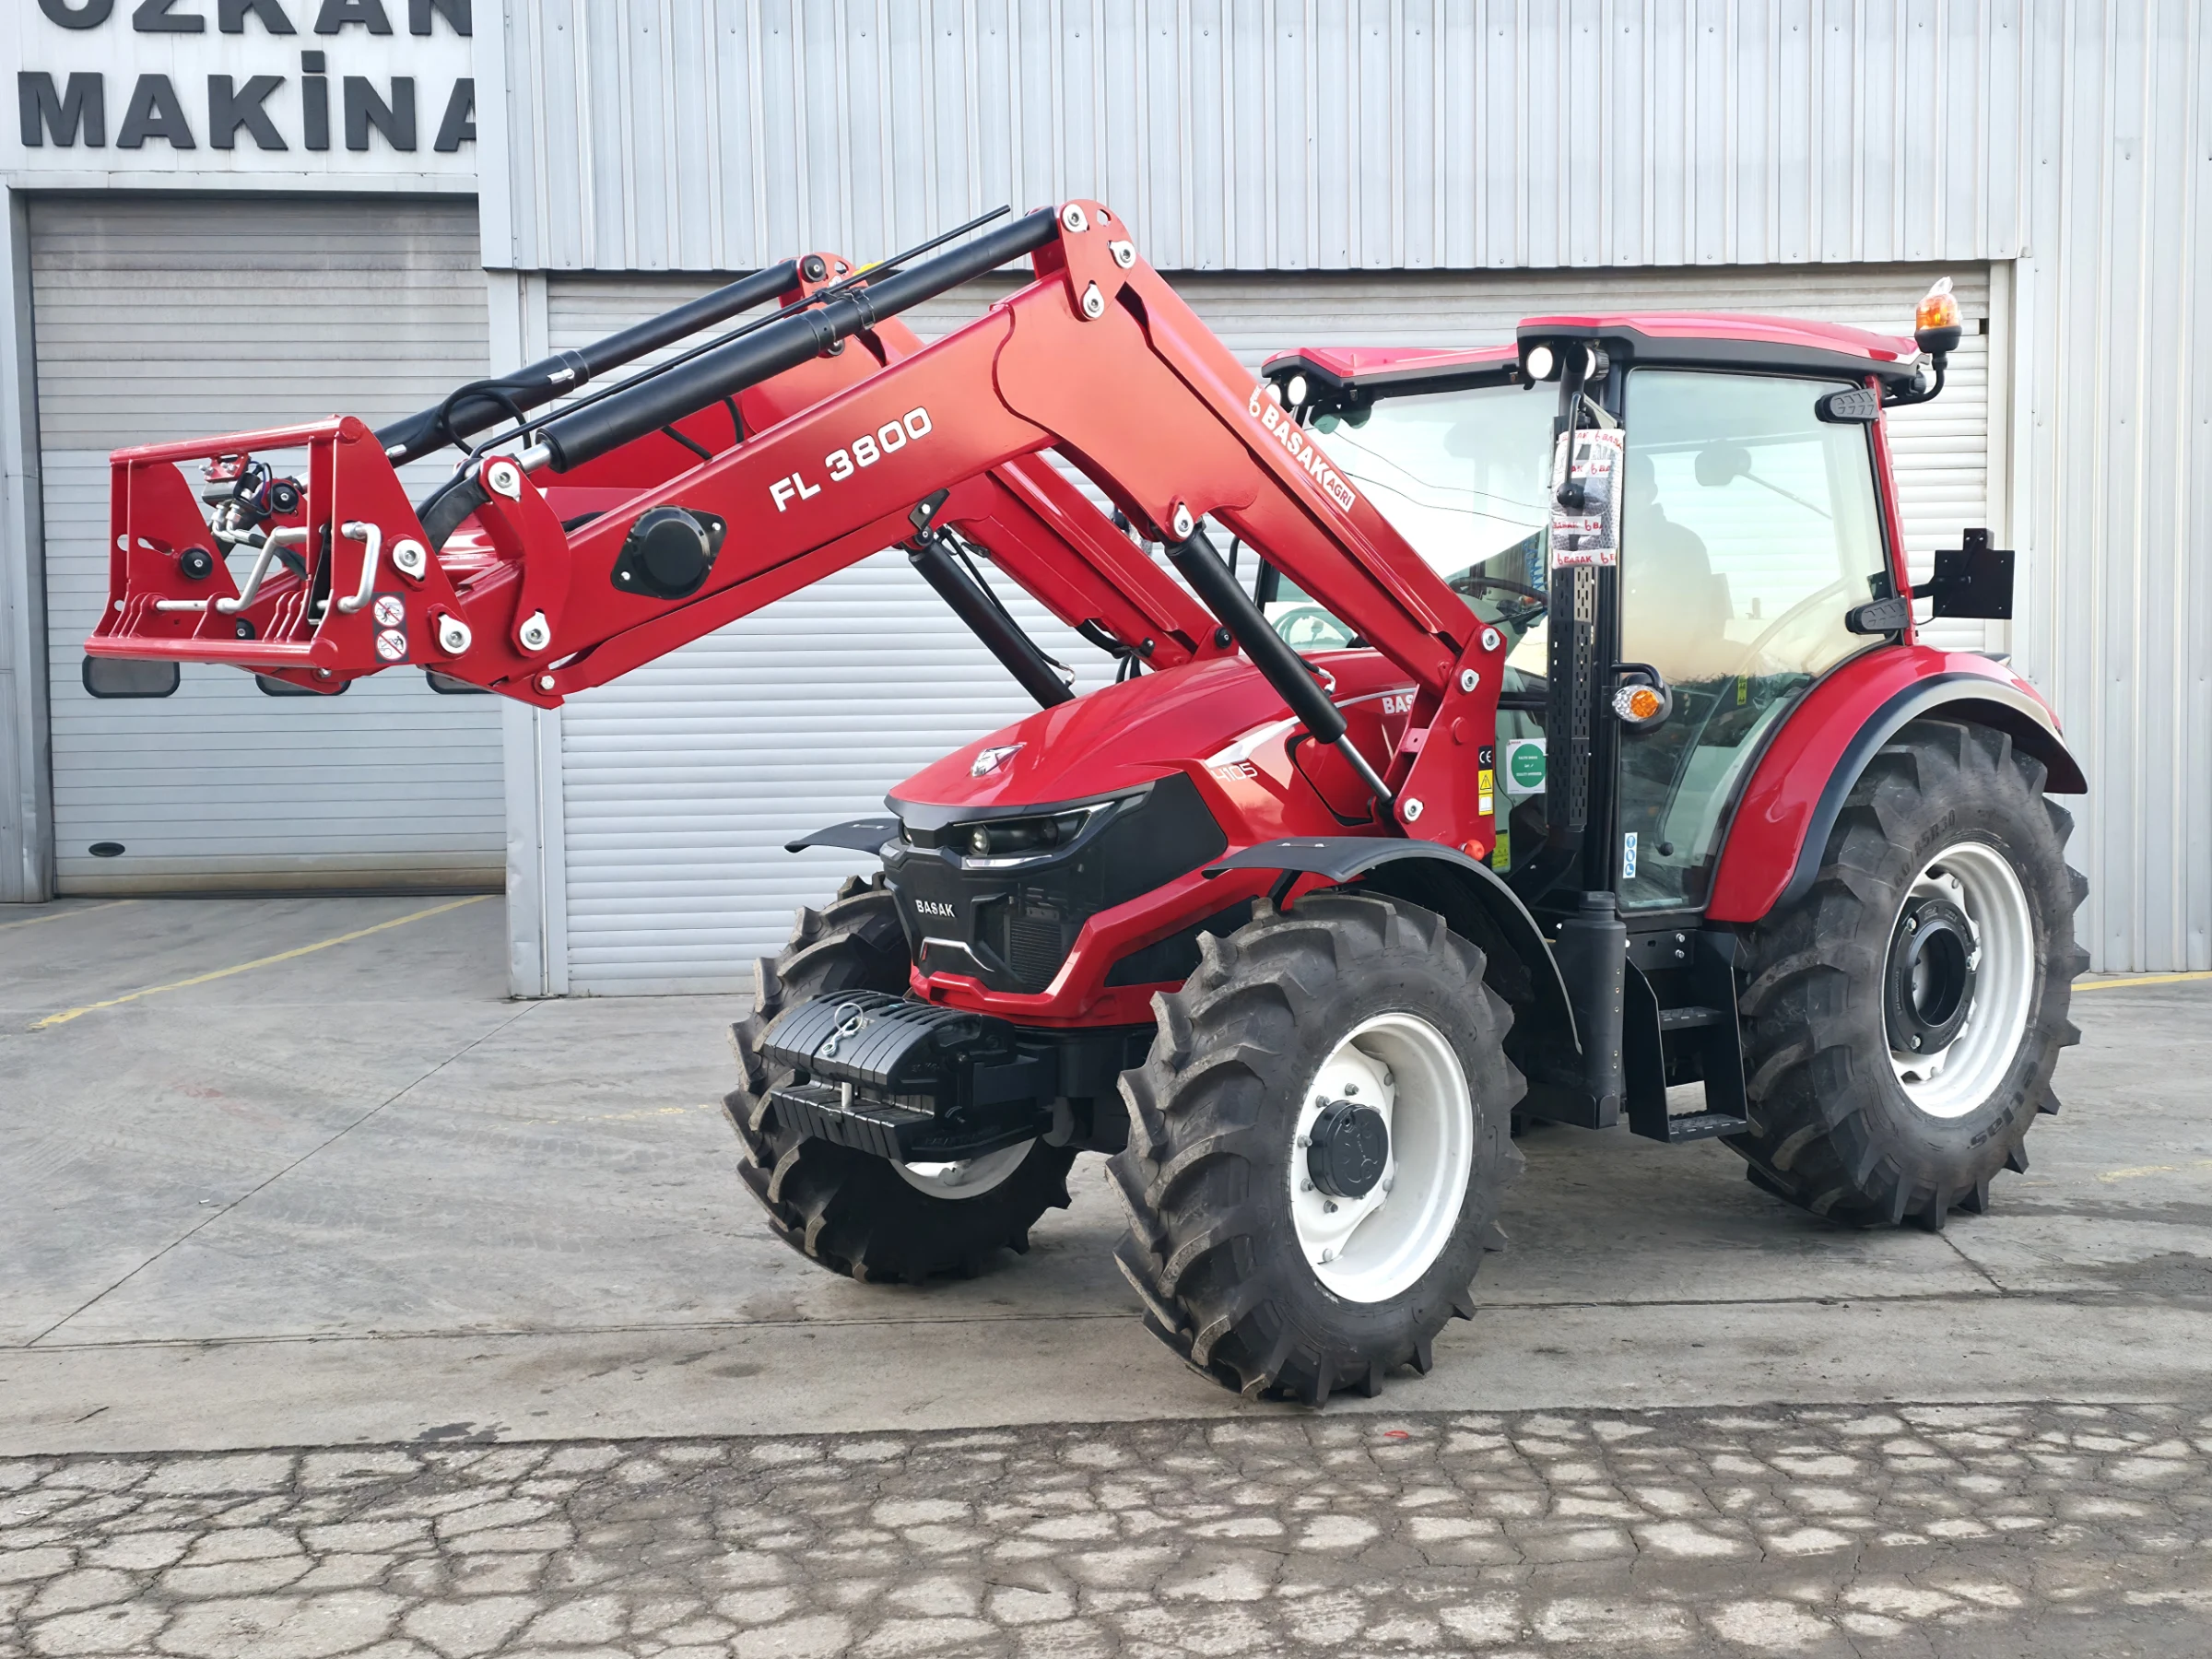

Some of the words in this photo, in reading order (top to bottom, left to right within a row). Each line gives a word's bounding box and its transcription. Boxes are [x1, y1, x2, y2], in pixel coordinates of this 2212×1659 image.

[769, 471, 821, 512] FL
[825, 406, 933, 482] 3800
[1261, 404, 1330, 485] BASAK
[1326, 477, 1352, 507] AGRI
[1382, 694, 1415, 714] BAS
[1210, 762, 1258, 782] 4105
[915, 900, 955, 918] BASAK
